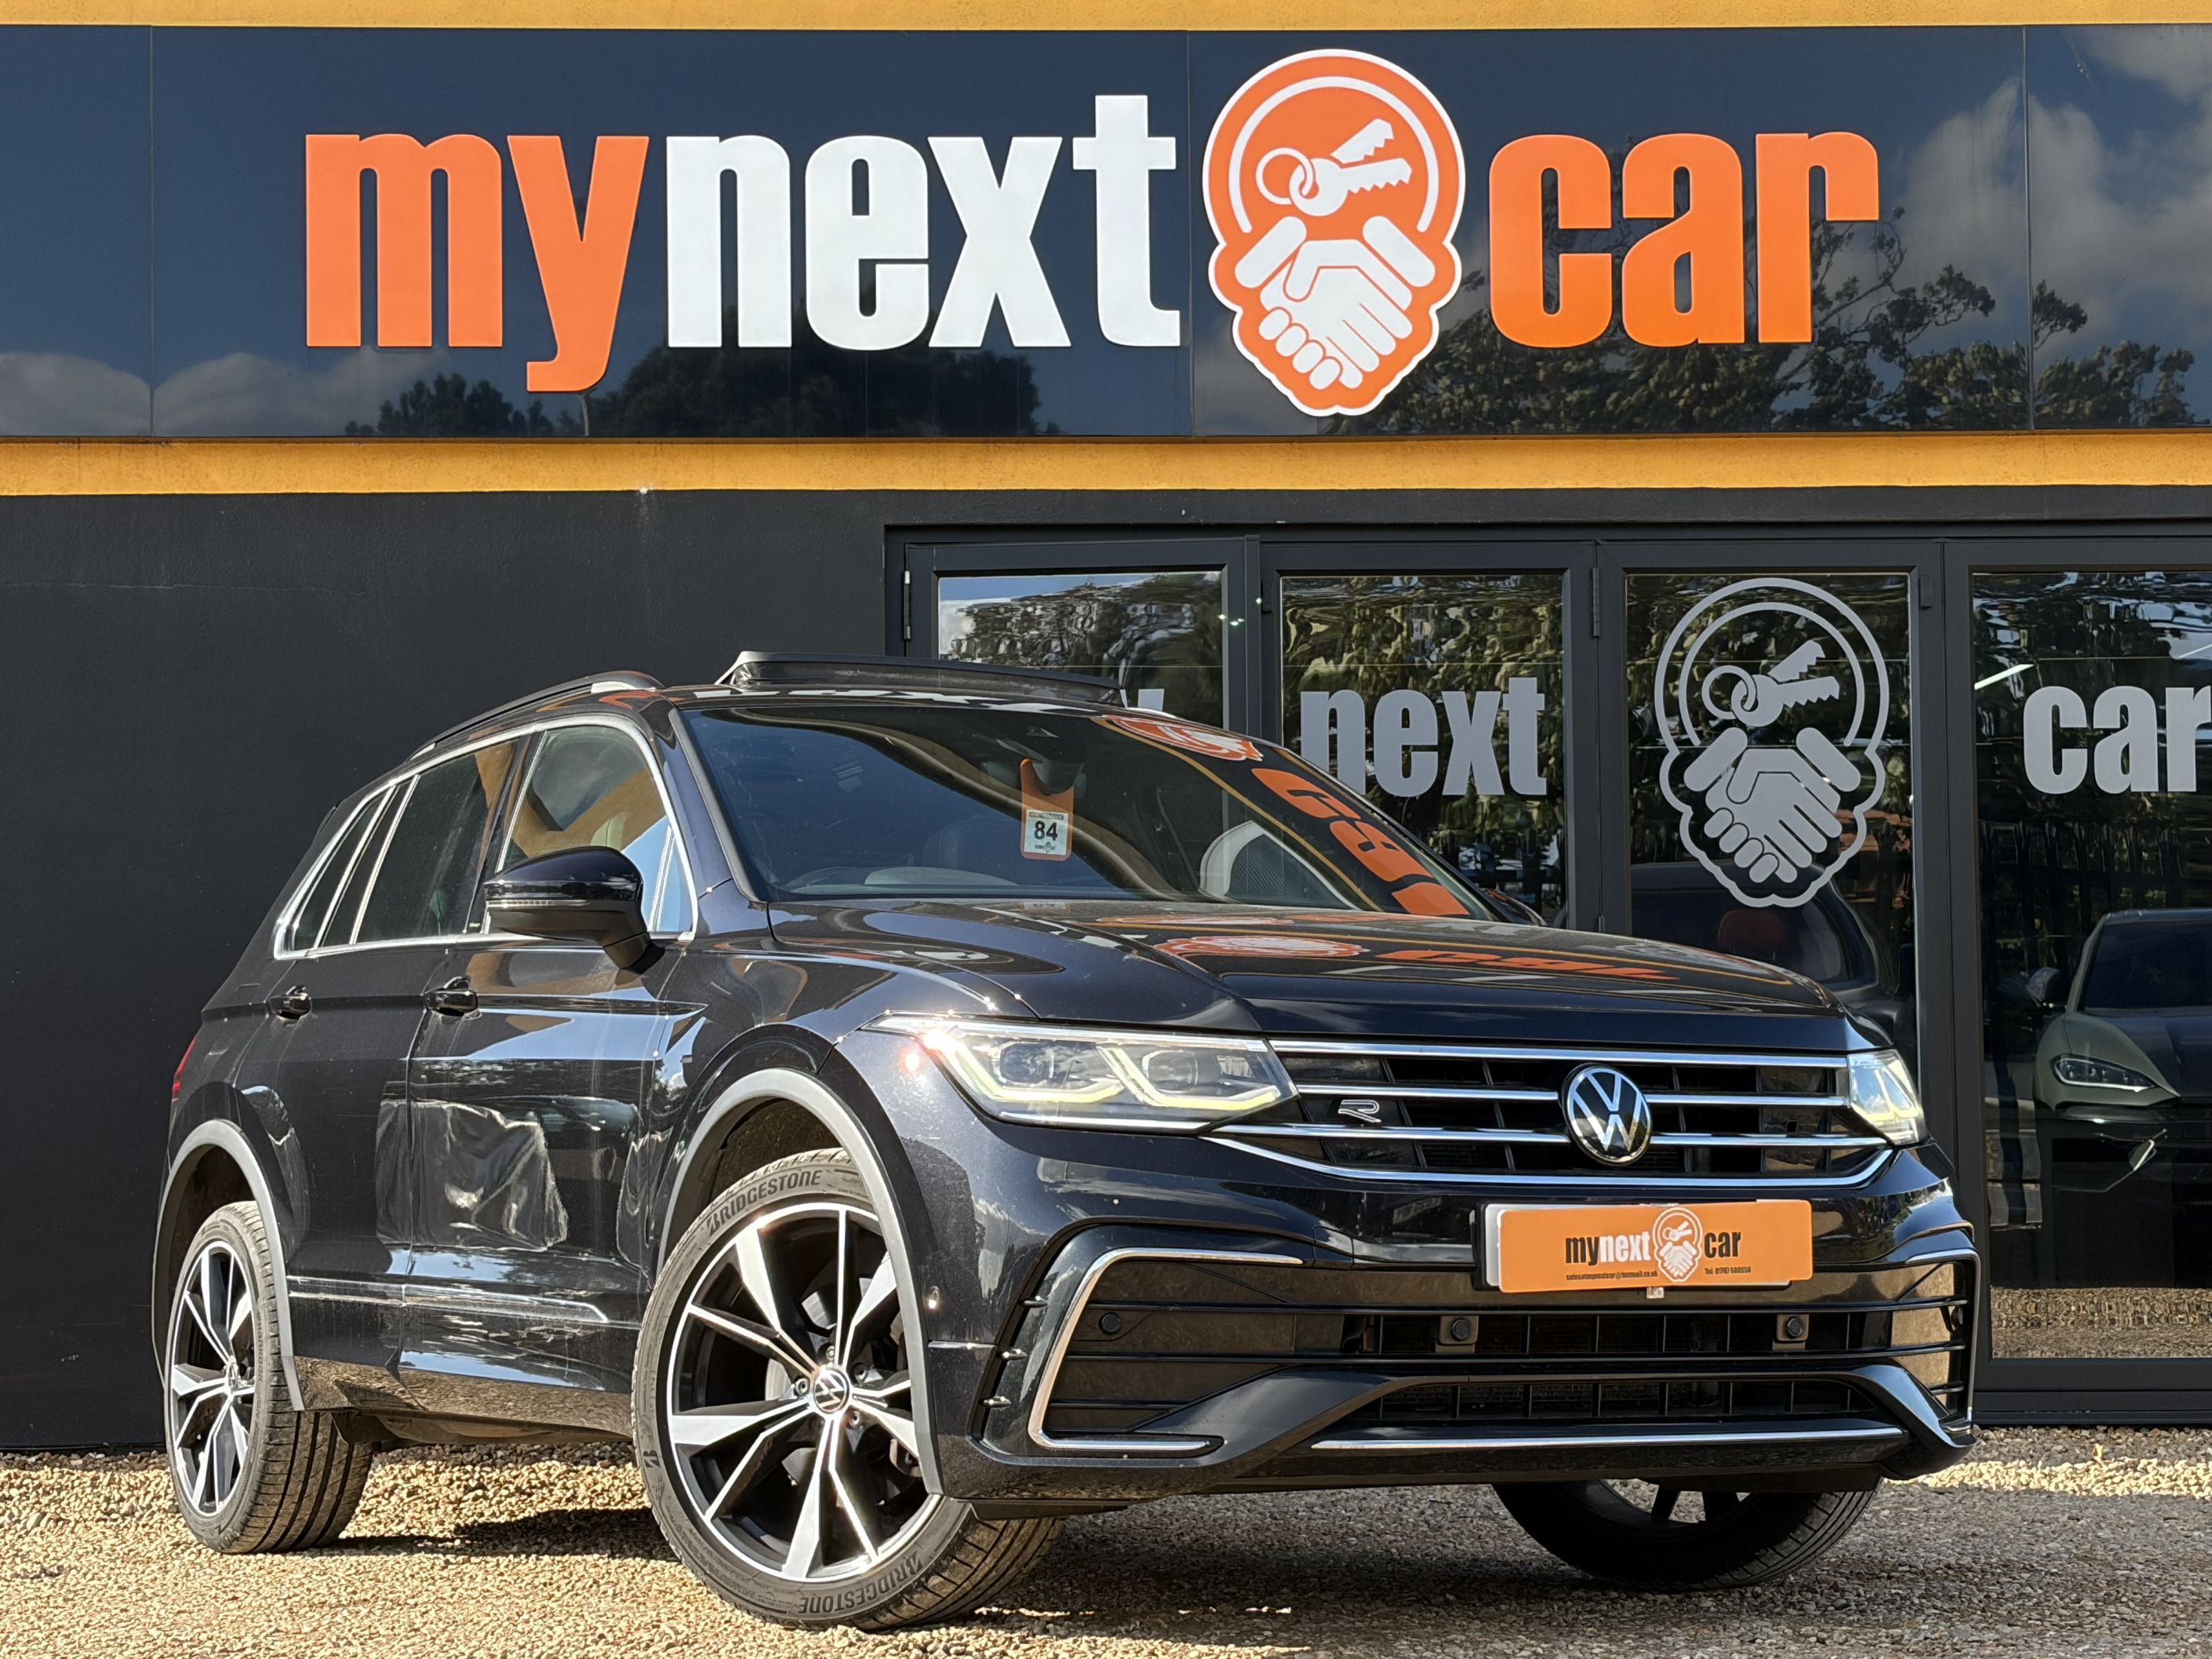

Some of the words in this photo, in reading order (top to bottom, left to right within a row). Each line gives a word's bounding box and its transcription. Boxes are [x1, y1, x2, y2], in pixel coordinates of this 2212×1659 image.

[1490, 134, 1878, 348] car
[1299, 678, 1547, 796] next
[2023, 686, 2212, 795] car
[1034, 820, 1058, 841] 84
[705, 1169, 824, 1237] BRIDGESTONE
[1704, 1231, 1742, 1259] car
[798, 1551, 924, 1614] BRIDGESTONE
